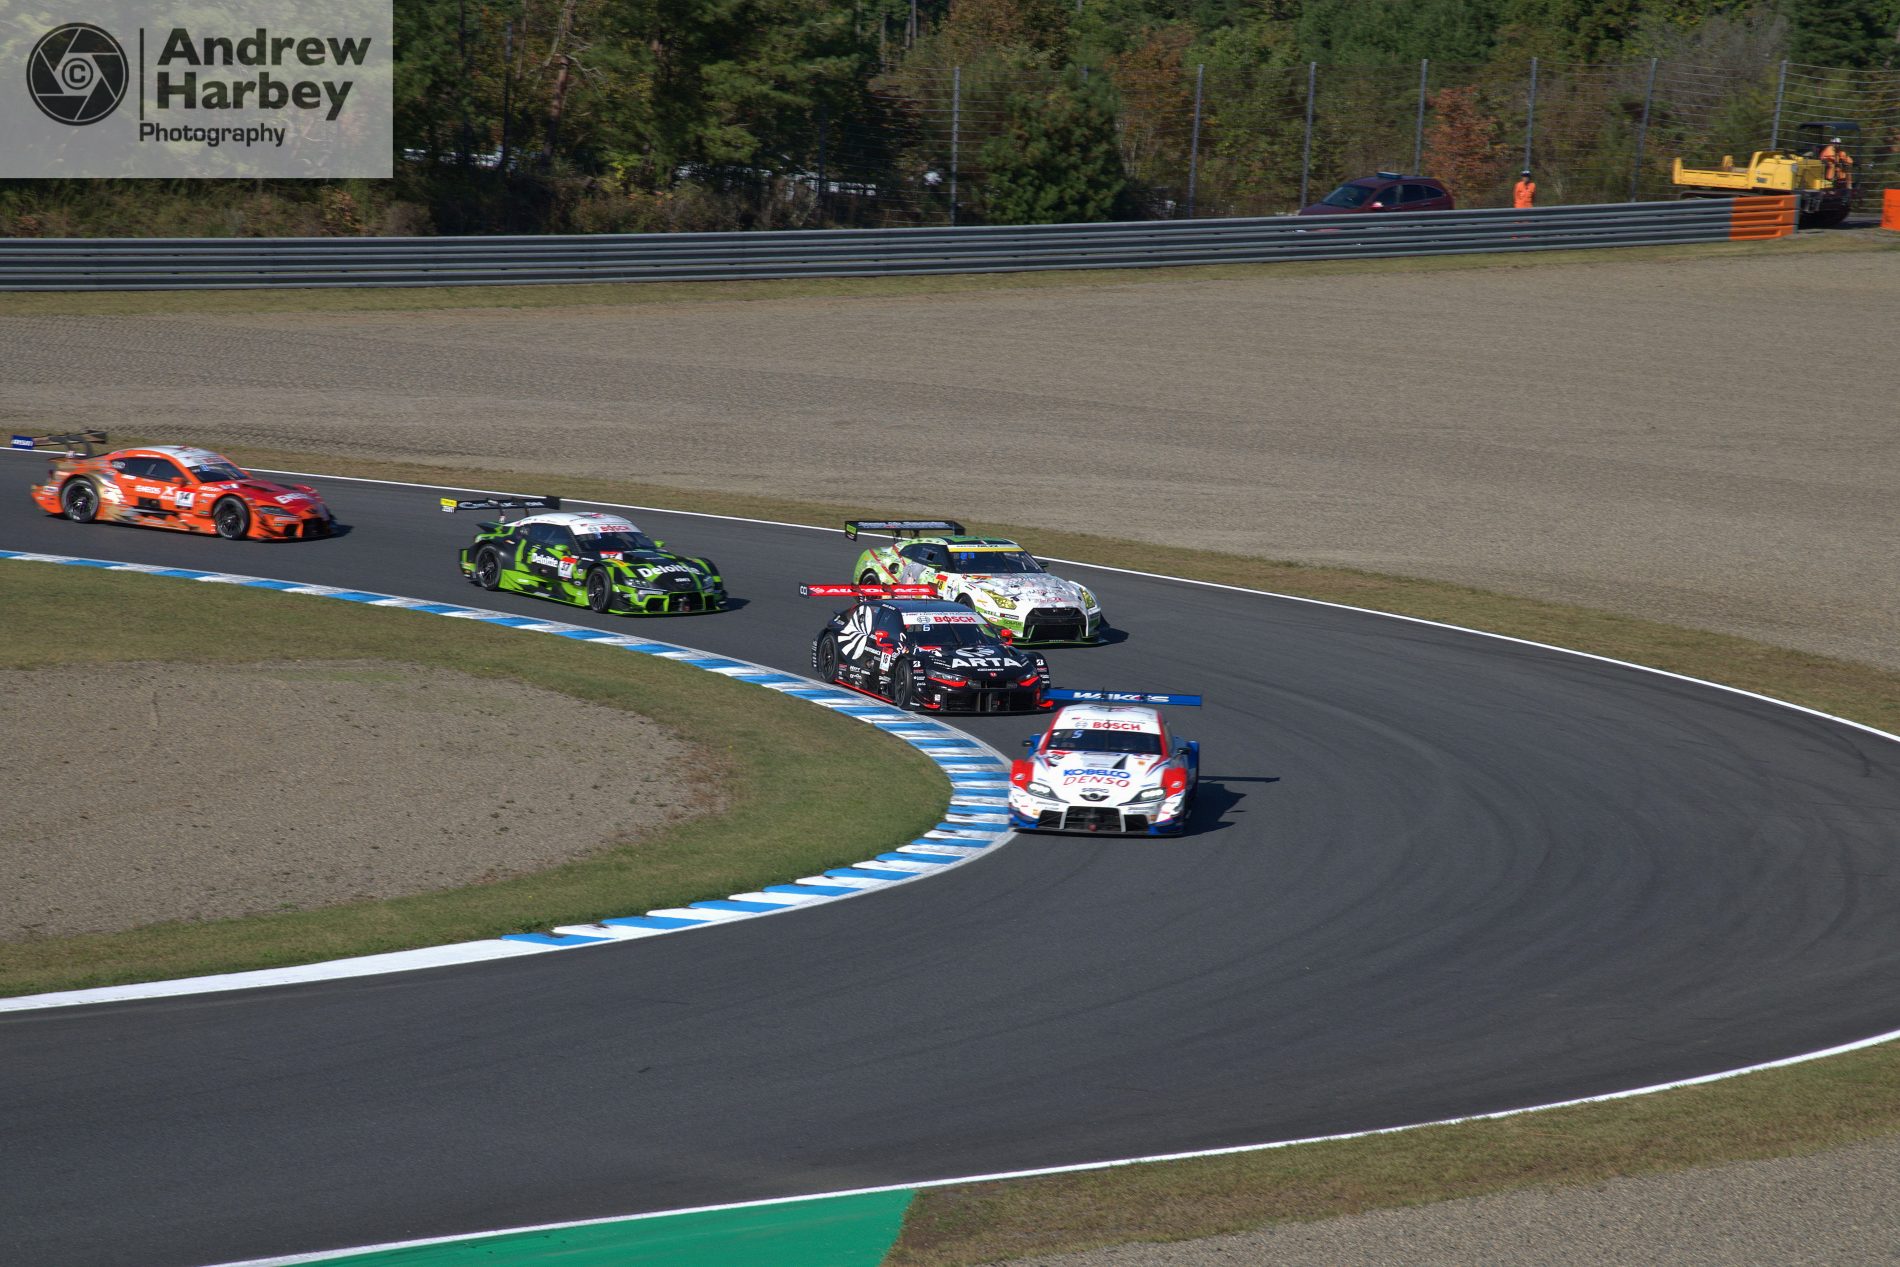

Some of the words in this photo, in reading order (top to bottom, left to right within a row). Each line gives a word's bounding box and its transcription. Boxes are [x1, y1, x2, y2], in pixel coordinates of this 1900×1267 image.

[637, 565, 701, 578] Deloitte
[951, 657, 1023, 669] ARTA
[1092, 721, 1141, 731] BOSCH
[1063, 768, 1131, 779] KOBELCO
[1063, 776, 1130, 788] DENSO
